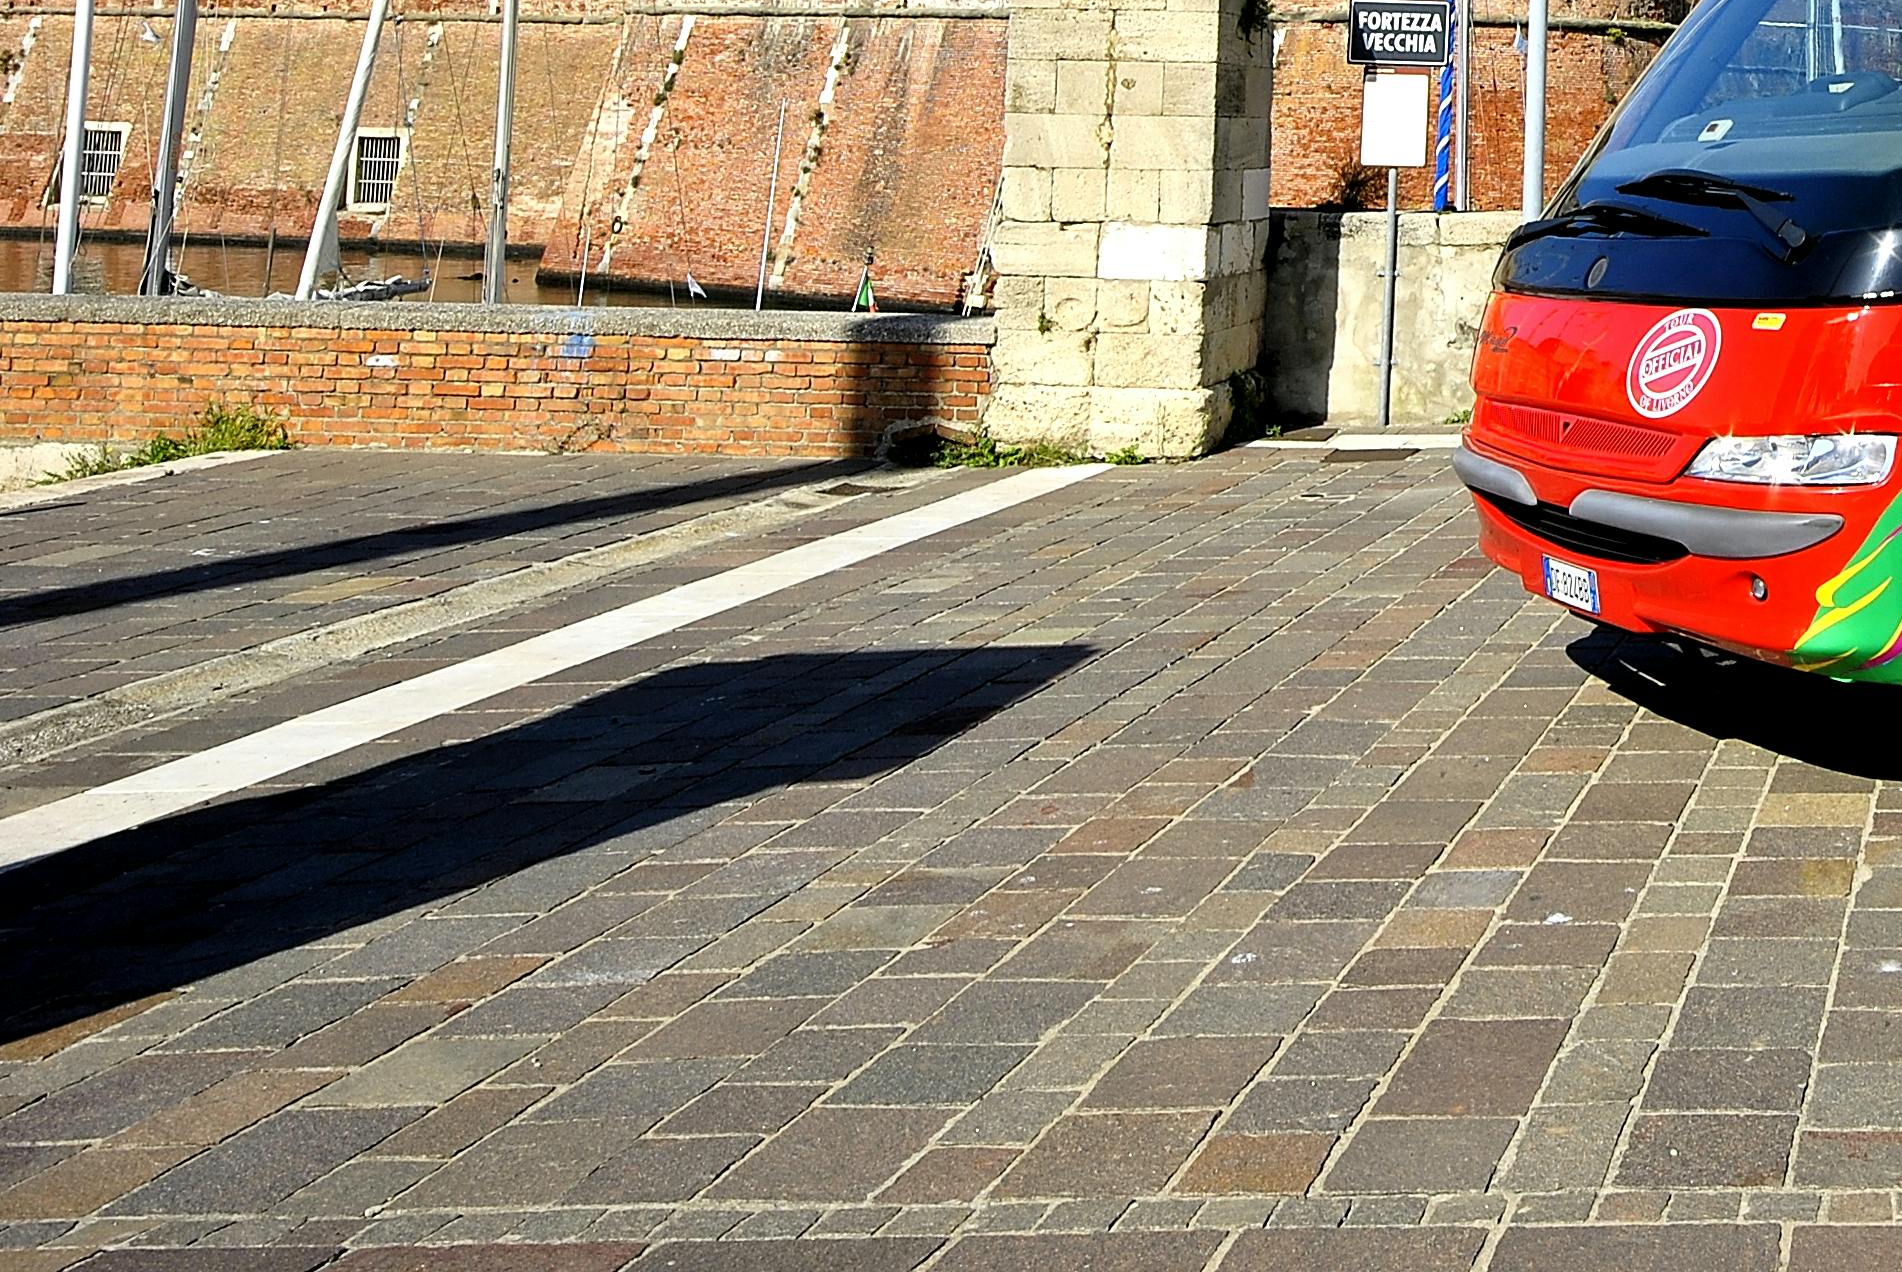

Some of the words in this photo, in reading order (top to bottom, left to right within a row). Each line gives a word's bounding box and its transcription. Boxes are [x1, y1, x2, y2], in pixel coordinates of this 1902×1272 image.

[1358, 11, 1442, 32] FORTEZZA
[1362, 32, 1437, 53] VECCHIA
[1663, 313, 1696, 332] TOUR
[1642, 339, 1701, 379] OFFICIAL
[1639, 395, 1653, 410] OF
[1652, 380, 1695, 412] LIVORNO
